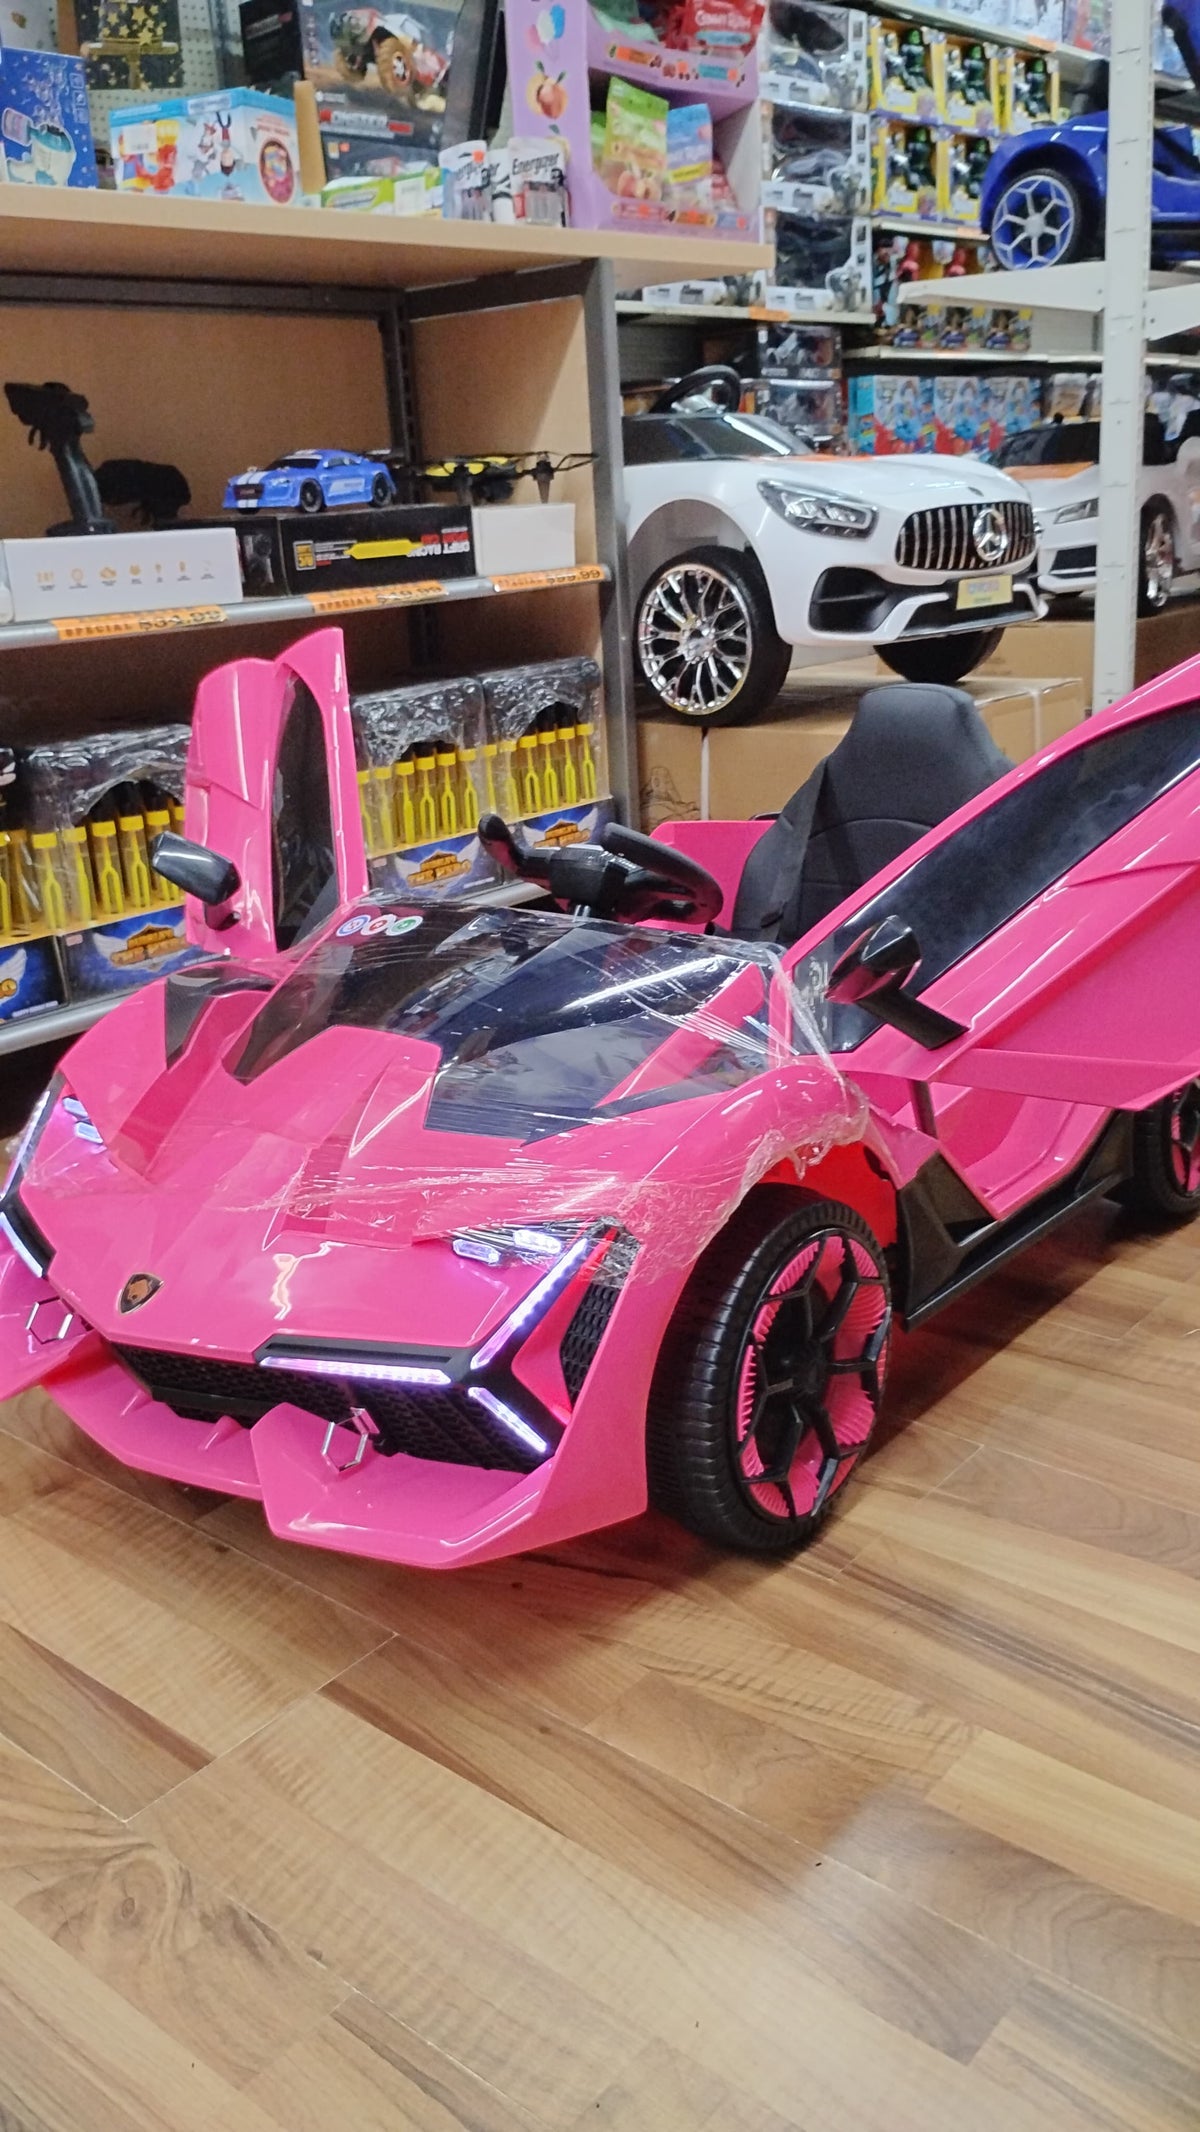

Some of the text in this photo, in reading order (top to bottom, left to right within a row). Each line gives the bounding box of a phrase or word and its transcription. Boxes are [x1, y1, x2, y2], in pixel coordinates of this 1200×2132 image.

[512, 153, 560, 176] Energizer
[319, 598, 373, 611] SPECIAL
[65, 623, 133, 638] SPECIAL
